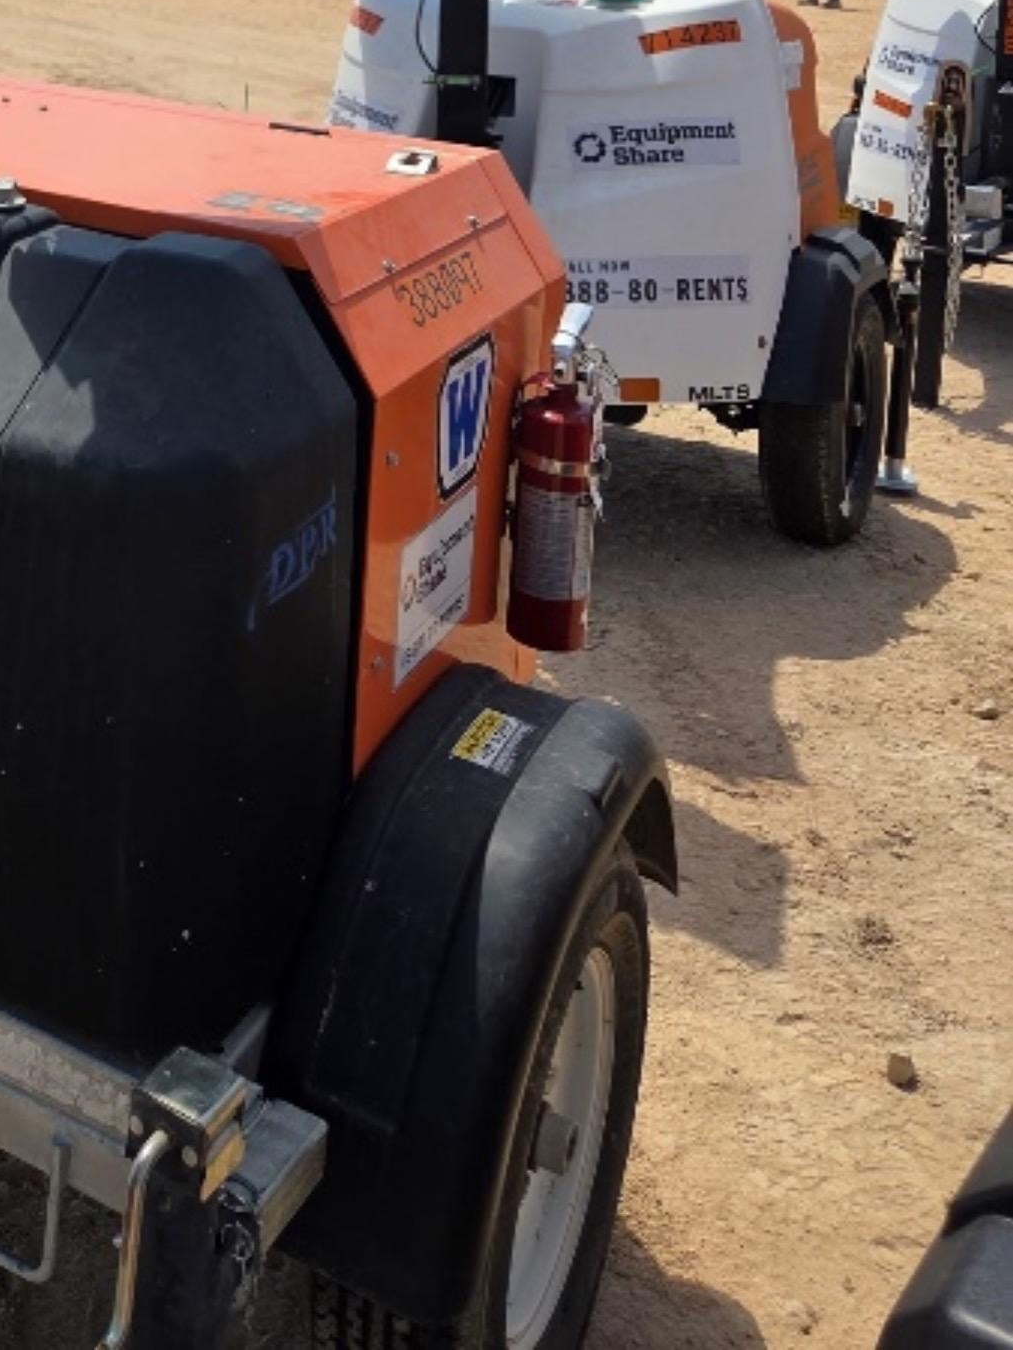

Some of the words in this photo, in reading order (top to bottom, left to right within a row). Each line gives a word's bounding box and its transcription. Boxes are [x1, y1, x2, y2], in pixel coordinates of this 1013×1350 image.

[608, 122, 736, 146] Equipment
[613, 147, 685, 166] Share
[448, 358, 487, 473] W
